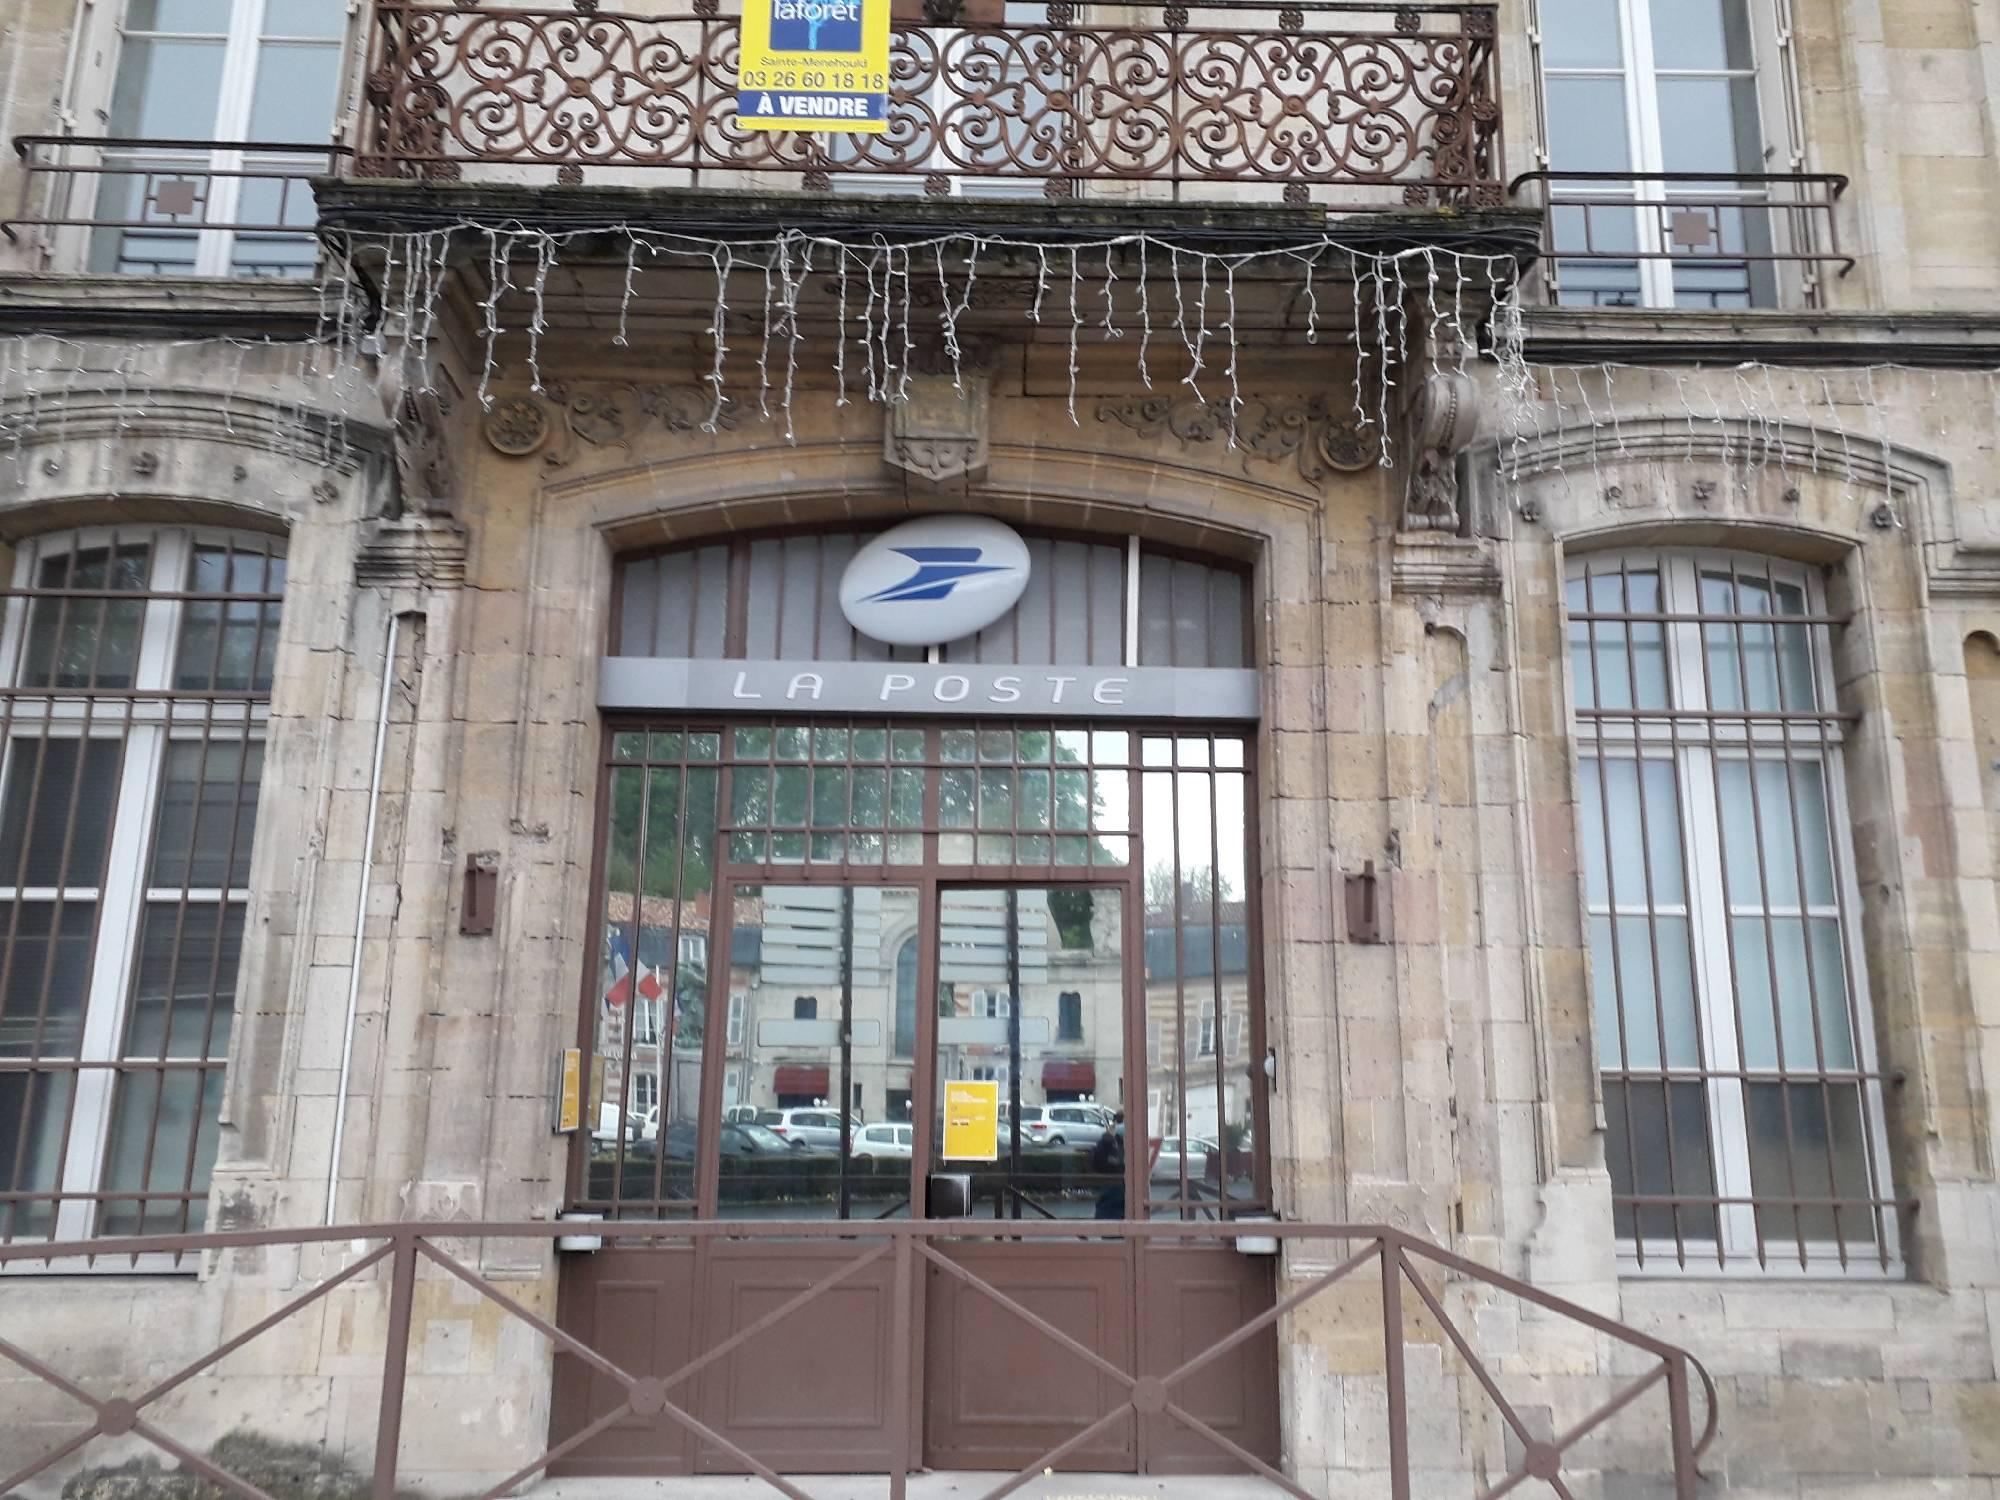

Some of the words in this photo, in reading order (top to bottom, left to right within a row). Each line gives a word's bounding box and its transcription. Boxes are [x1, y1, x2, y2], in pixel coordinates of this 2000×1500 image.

[743, 71, 767, 87] 03
[773, 71, 796, 87] 26
[802, 72, 825, 88] 60
[832, 73, 855, 89] 18
[862, 73, 884, 89] 18
[757, 92, 774, 115] À
[779, 96, 869, 117] VENDRE
[732, 671, 824, 699] LA
[879, 673, 1129, 704] POSTE
